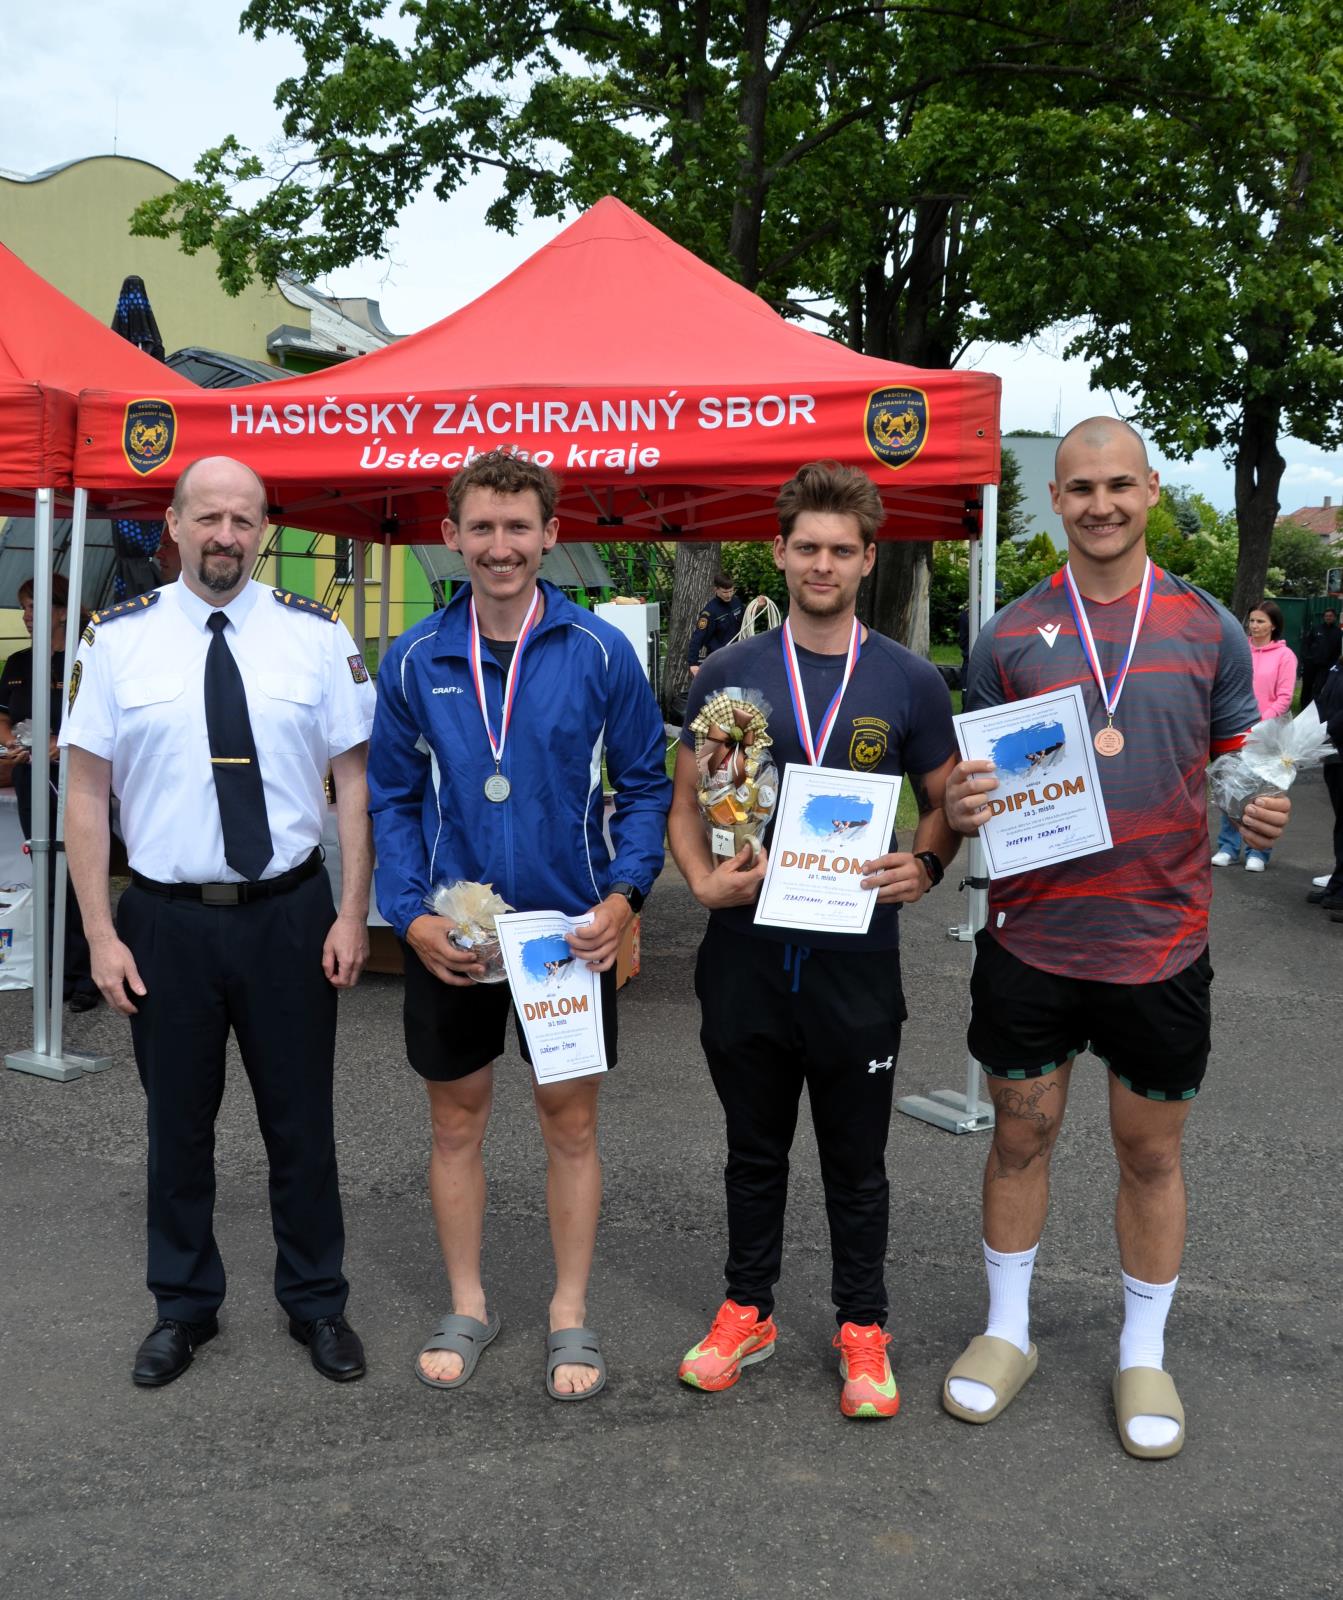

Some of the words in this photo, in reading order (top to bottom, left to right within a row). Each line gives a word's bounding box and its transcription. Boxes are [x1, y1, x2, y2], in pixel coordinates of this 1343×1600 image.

[230, 395, 422, 434] HASIČSKÝ
[433, 390, 685, 433] ZÁCHRANNÝ
[697, 394, 816, 430] SBOR
[566, 442, 661, 474] kraje
[431, 686, 457, 694] CRAFT
[987, 775, 1086, 817] DIPLOM
[780, 850, 871, 875] DIPLOM
[523, 994, 589, 1022] DIPLOM
